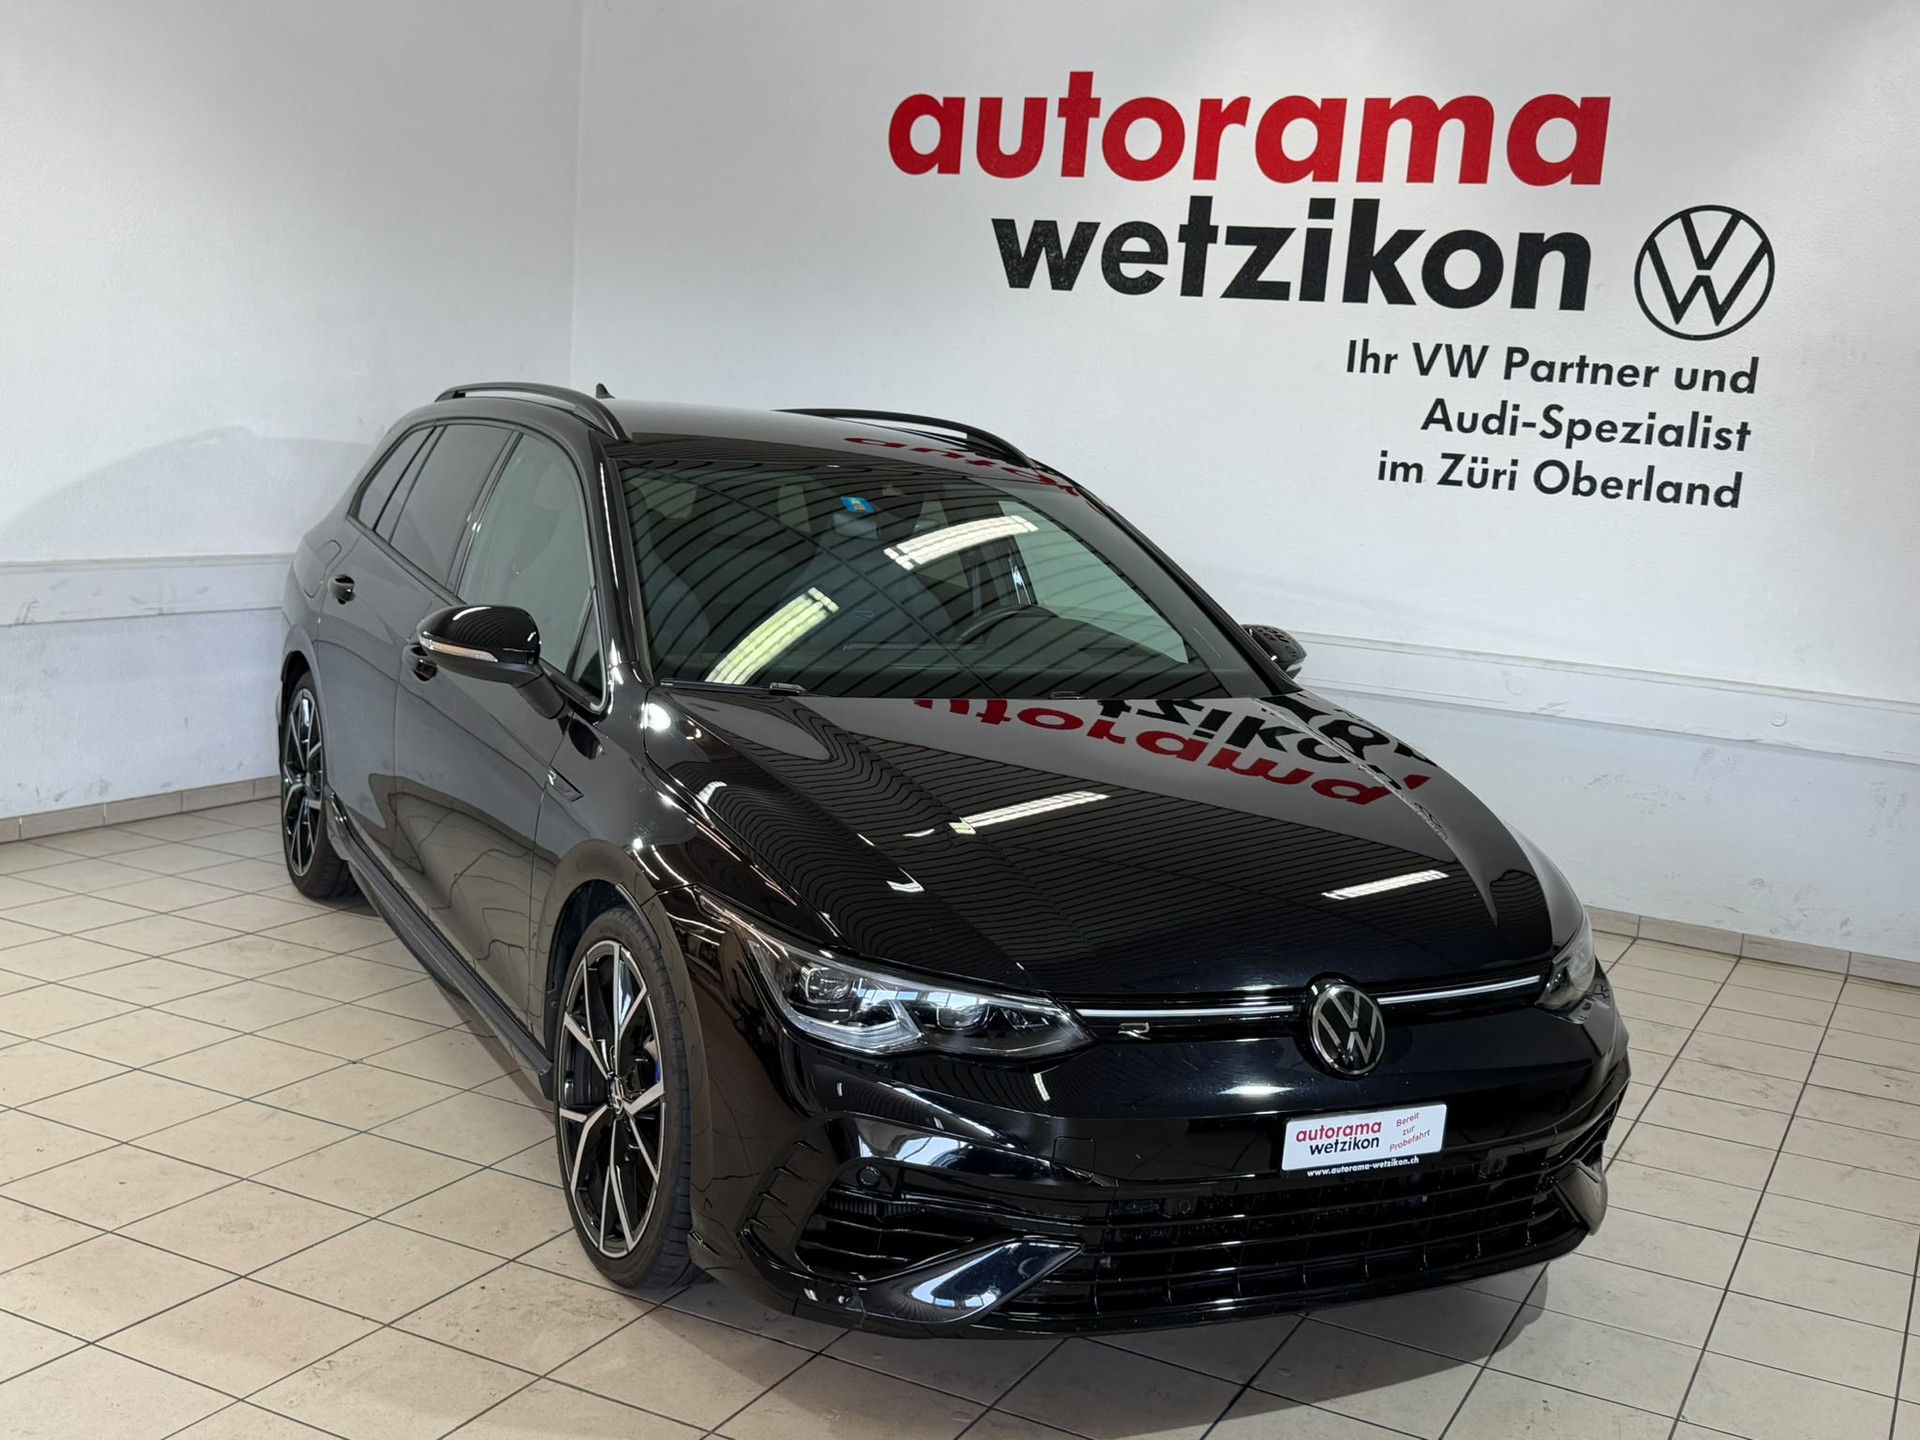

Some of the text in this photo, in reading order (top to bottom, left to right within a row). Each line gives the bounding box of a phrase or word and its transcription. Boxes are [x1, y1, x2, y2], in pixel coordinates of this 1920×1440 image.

[888, 71, 1611, 187] autorama
[991, 195, 1592, 311] wetzikon
[1346, 339, 1760, 394] Ihr VW Partner und
[1420, 397, 1752, 452] Audi-Spezialist
[1378, 450, 1743, 509] im Züri Oberland
[1396, 1112, 1420, 1127] Bereit
[1402, 1125, 1416, 1136] zur
[1296, 1120, 1382, 1143] autorama
[1389, 1129, 1431, 1152] Probefahrt
[1309, 1136, 1380, 1156] wetzikon
[1306, 1155, 1420, 1177] www.autorama-wetzikon.ch
